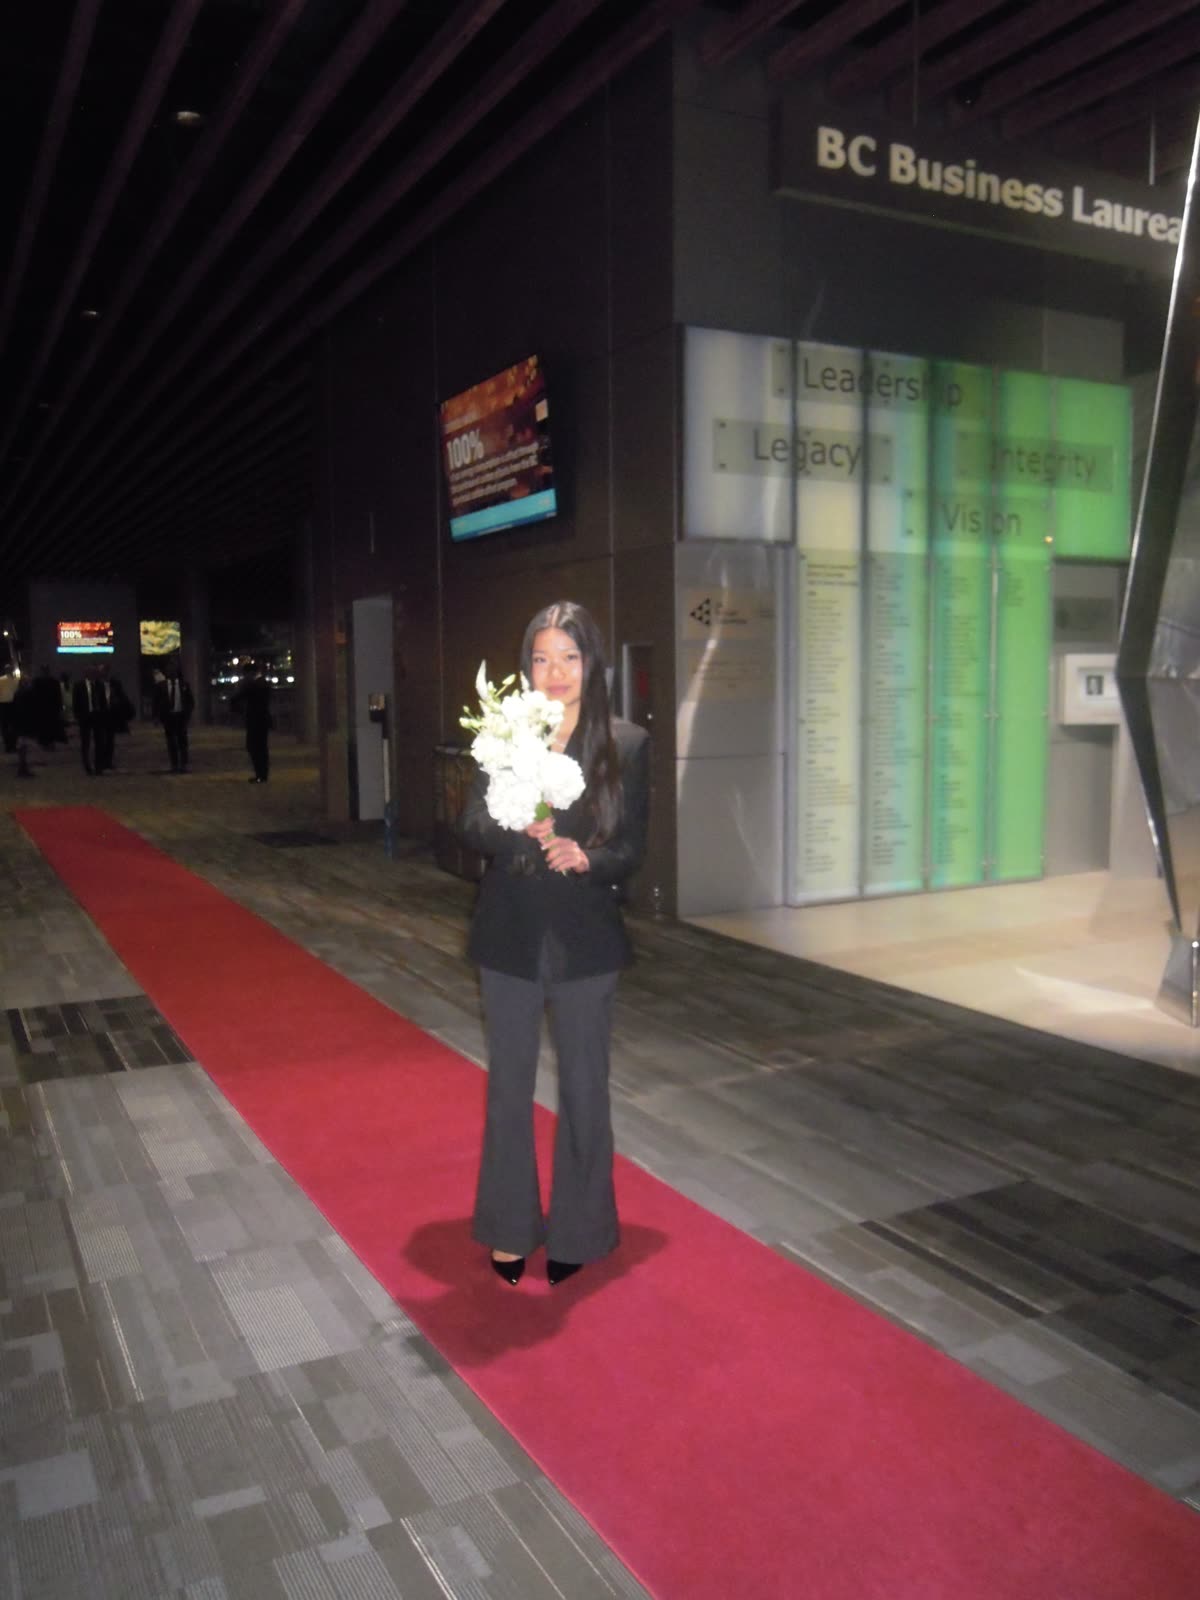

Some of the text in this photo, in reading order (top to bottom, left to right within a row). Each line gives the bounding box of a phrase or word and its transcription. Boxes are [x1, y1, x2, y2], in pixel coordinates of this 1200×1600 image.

[816, 126, 877, 177] BC
[889, 143, 1064, 219] Business
[803, 358, 963, 411] Leaersp
[447, 428, 484, 469] 100%
[753, 429, 861, 475] Legacy
[992, 446, 1097, 488] ntegrity
[942, 503, 1022, 537] Vison
[61, 630, 82, 639] 100%
